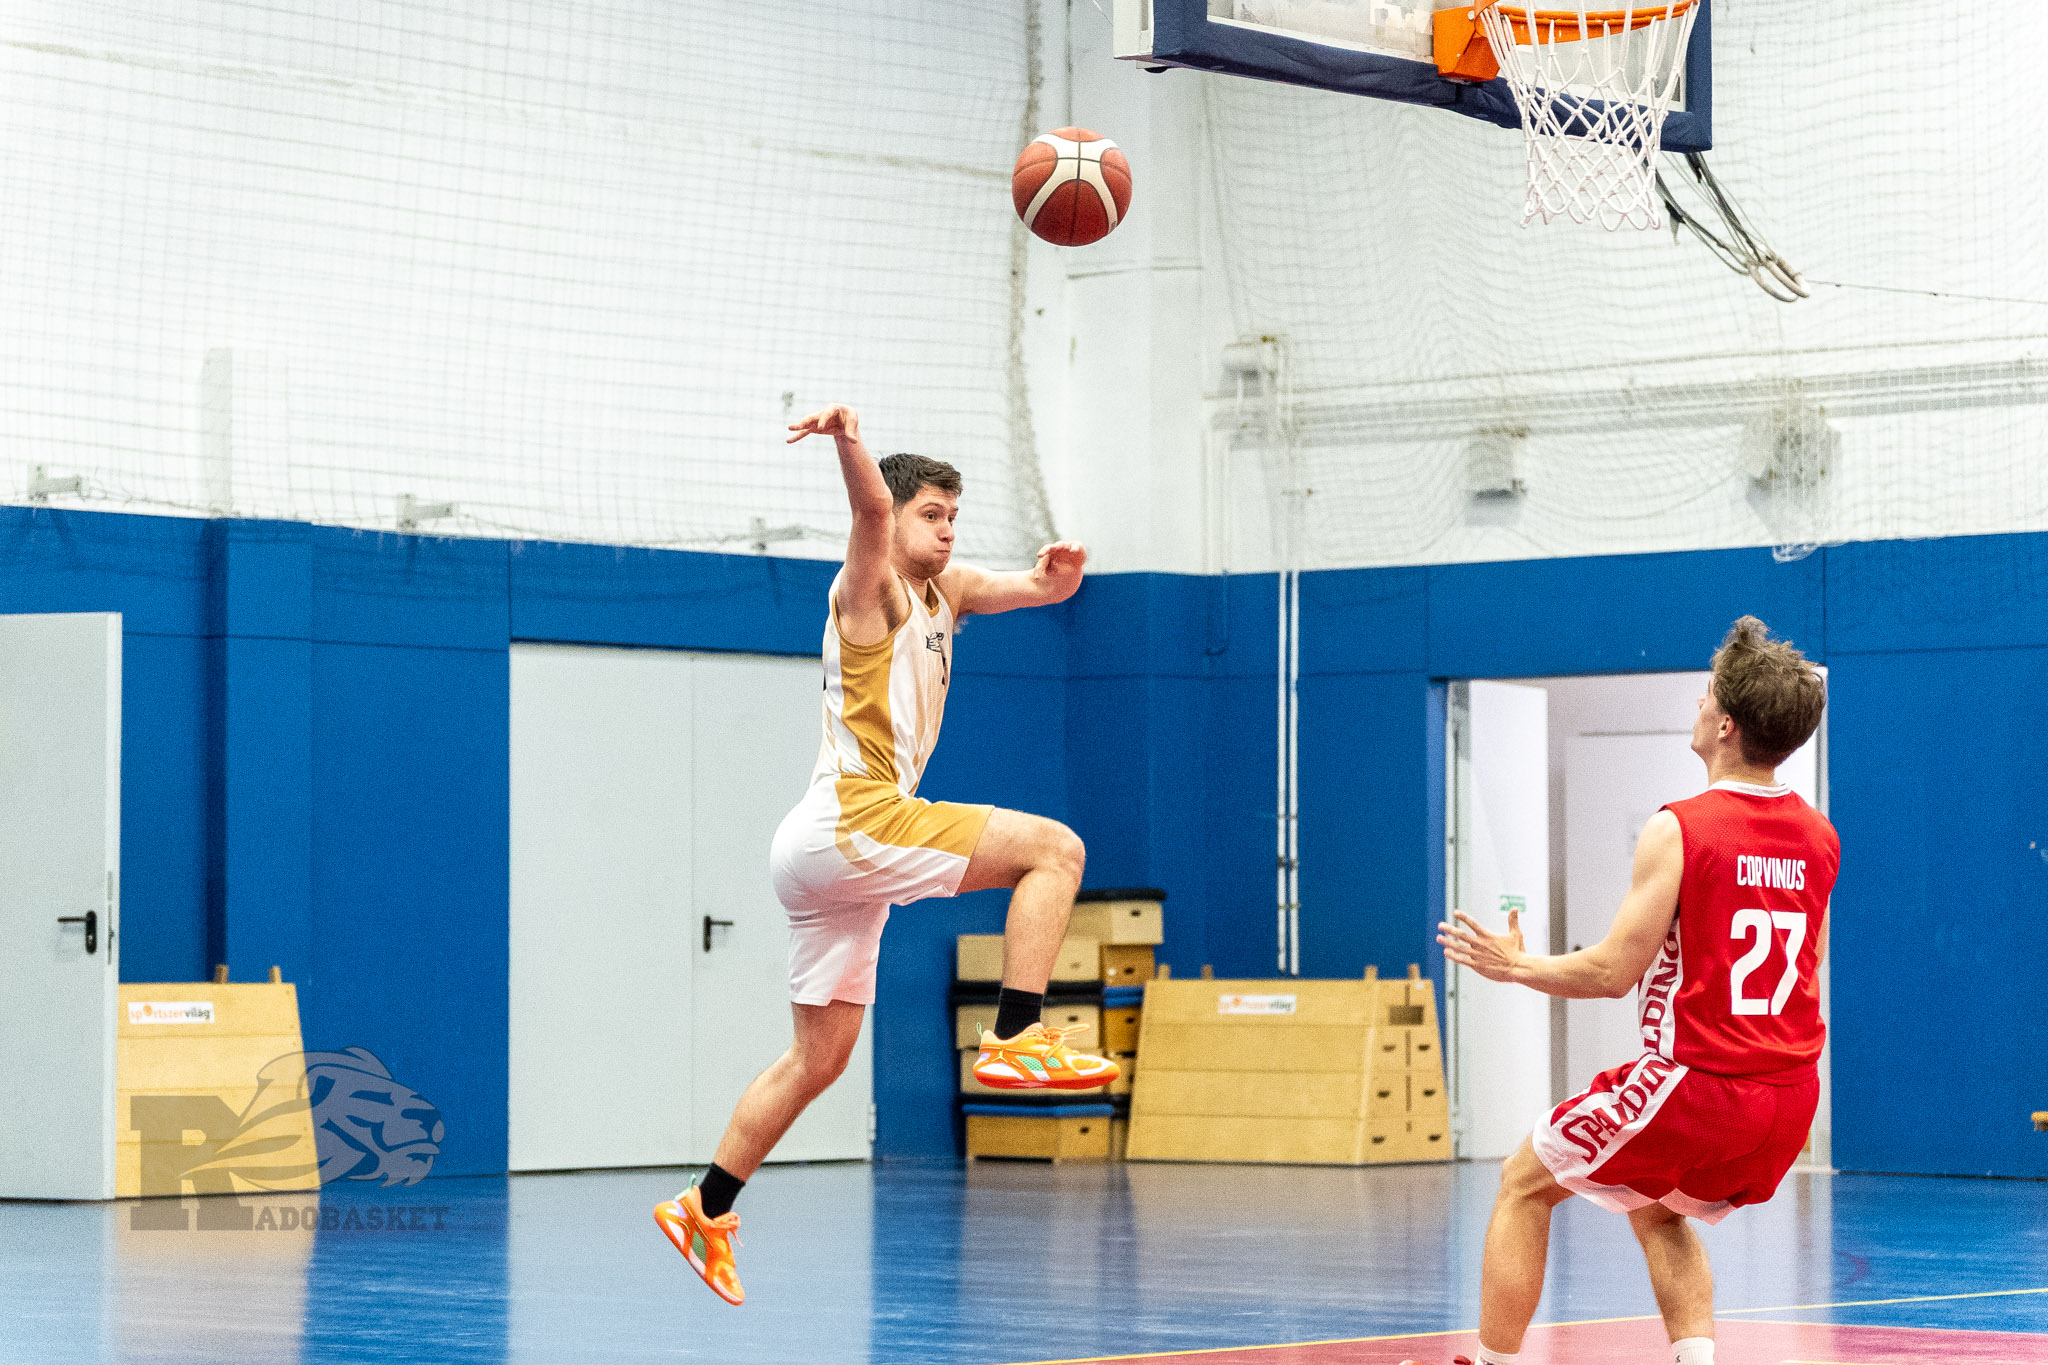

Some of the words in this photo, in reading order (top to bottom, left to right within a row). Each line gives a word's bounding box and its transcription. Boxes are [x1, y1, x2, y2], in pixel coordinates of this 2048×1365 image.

[1737, 855, 1806, 890] CORVINUS
[1641, 931, 1680, 1056] LDING
[1730, 908, 1807, 1016] 27
[1561, 1058, 1679, 1165] SPALDIN
